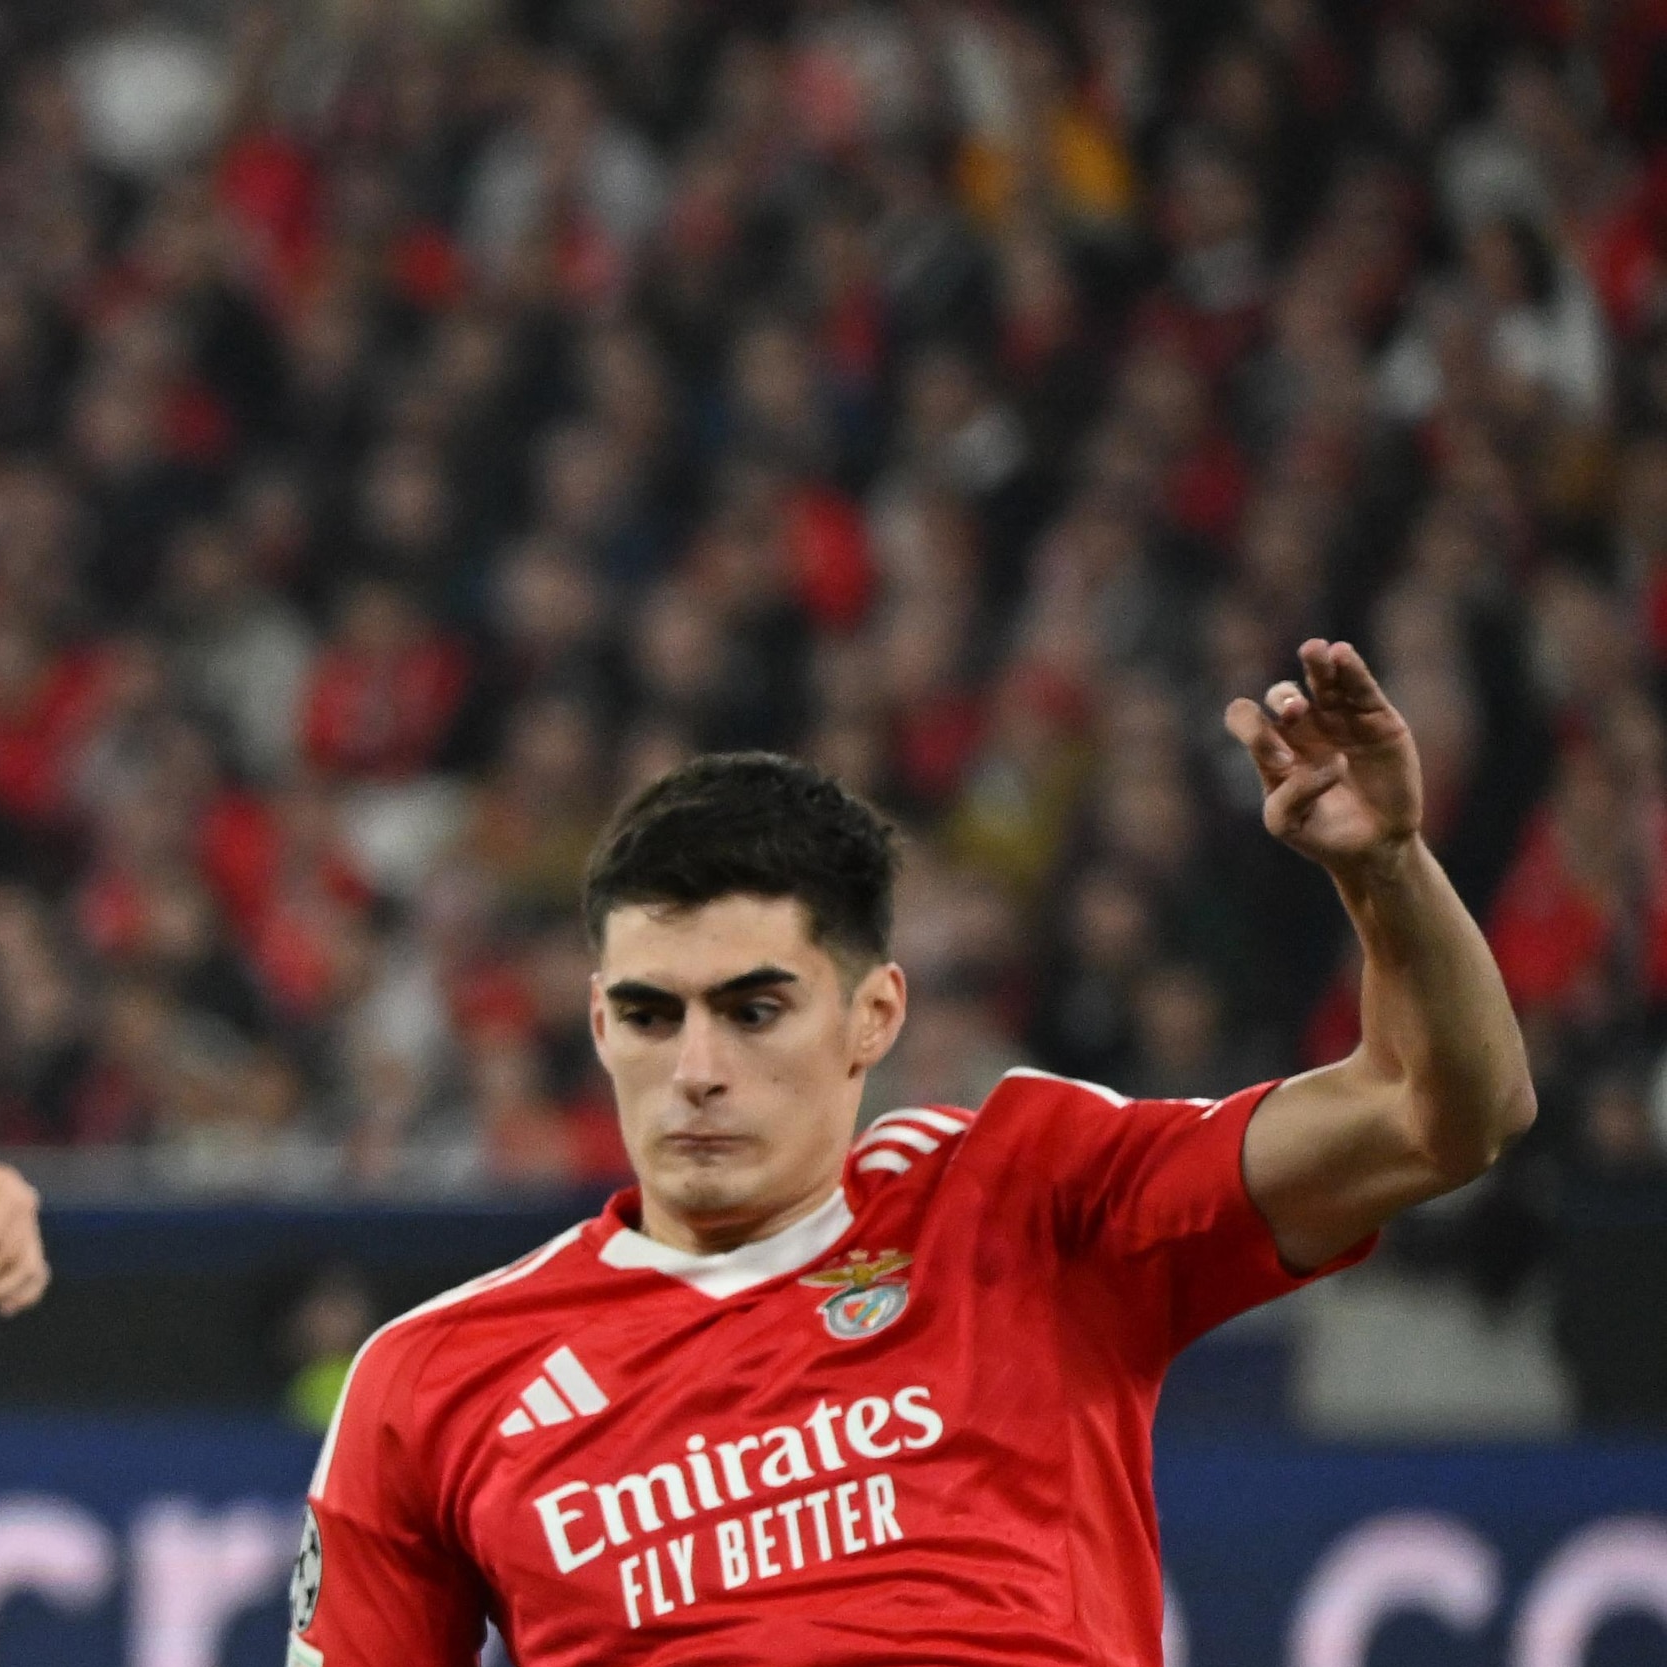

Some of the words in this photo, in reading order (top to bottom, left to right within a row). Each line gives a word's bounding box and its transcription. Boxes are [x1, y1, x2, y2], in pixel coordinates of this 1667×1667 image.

[534, 1385, 944, 1574] Emirates
[620, 1534, 696, 1629] FLY
[716, 1474, 904, 1590] BETTER
